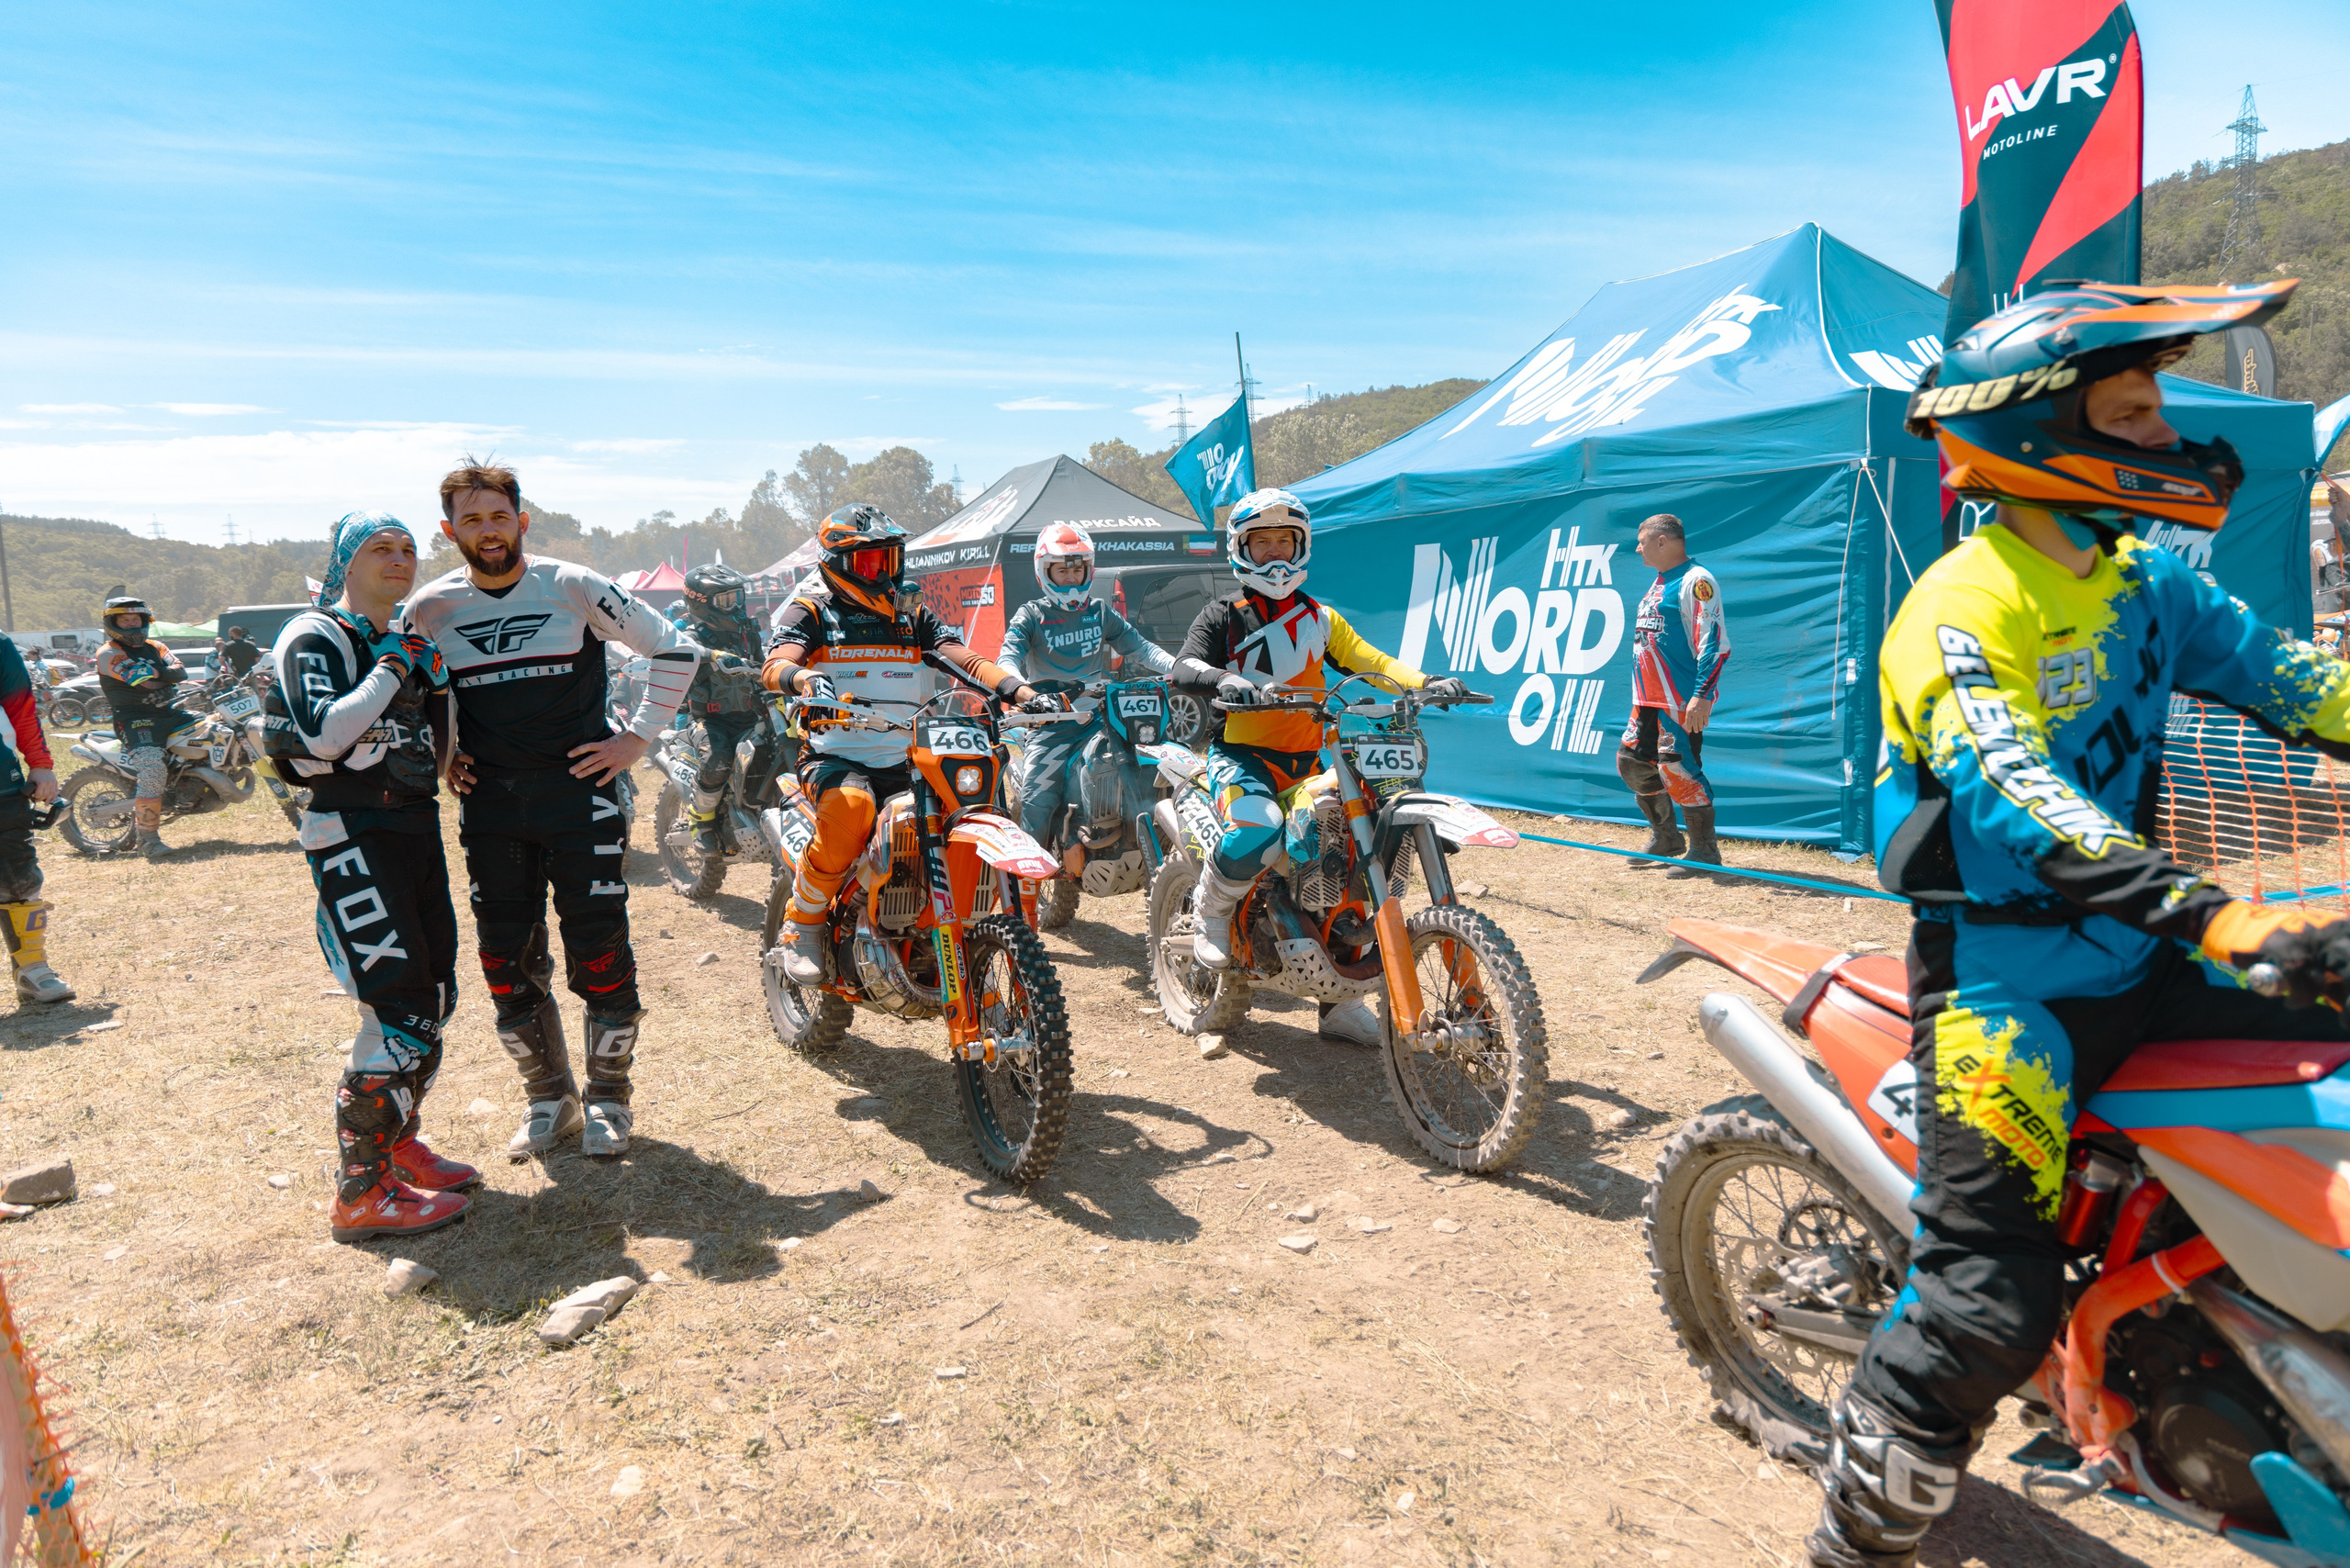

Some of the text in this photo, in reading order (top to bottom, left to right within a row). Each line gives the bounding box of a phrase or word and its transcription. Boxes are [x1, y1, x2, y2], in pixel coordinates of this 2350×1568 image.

[1964, 58, 2107, 141] LAVR
[1983, 124, 2058, 161] MOTOLINE
[1913, 362, 2077, 418] 100%
[959, 545, 990, 561] KIRILL
[1097, 542, 1175, 551] KHAKASSIA
[1397, 535, 1626, 676] NORD
[828, 648, 914, 660] ADRENALIN
[1081, 638, 1102, 657] 23
[498, 666, 566, 681] RACING
[229, 699, 253, 714] 507
[1123, 699, 1158, 712] 467
[1507, 673, 1606, 755] OIL
[934, 731, 989, 752] 466
[1365, 749, 1415, 770] 465
[589, 795, 627, 896] FLY
[786, 830, 809, 854] 46
[1195, 815, 1222, 848] 465
[323, 846, 408, 973] FOX
[941, 933, 957, 994] DUNLOP
[403, 1014, 439, 1035] 360
[596, 1025, 635, 1057] G
[1953, 1054, 2064, 1165] EXTREME
[1978, 1108, 2046, 1168] MOTO
